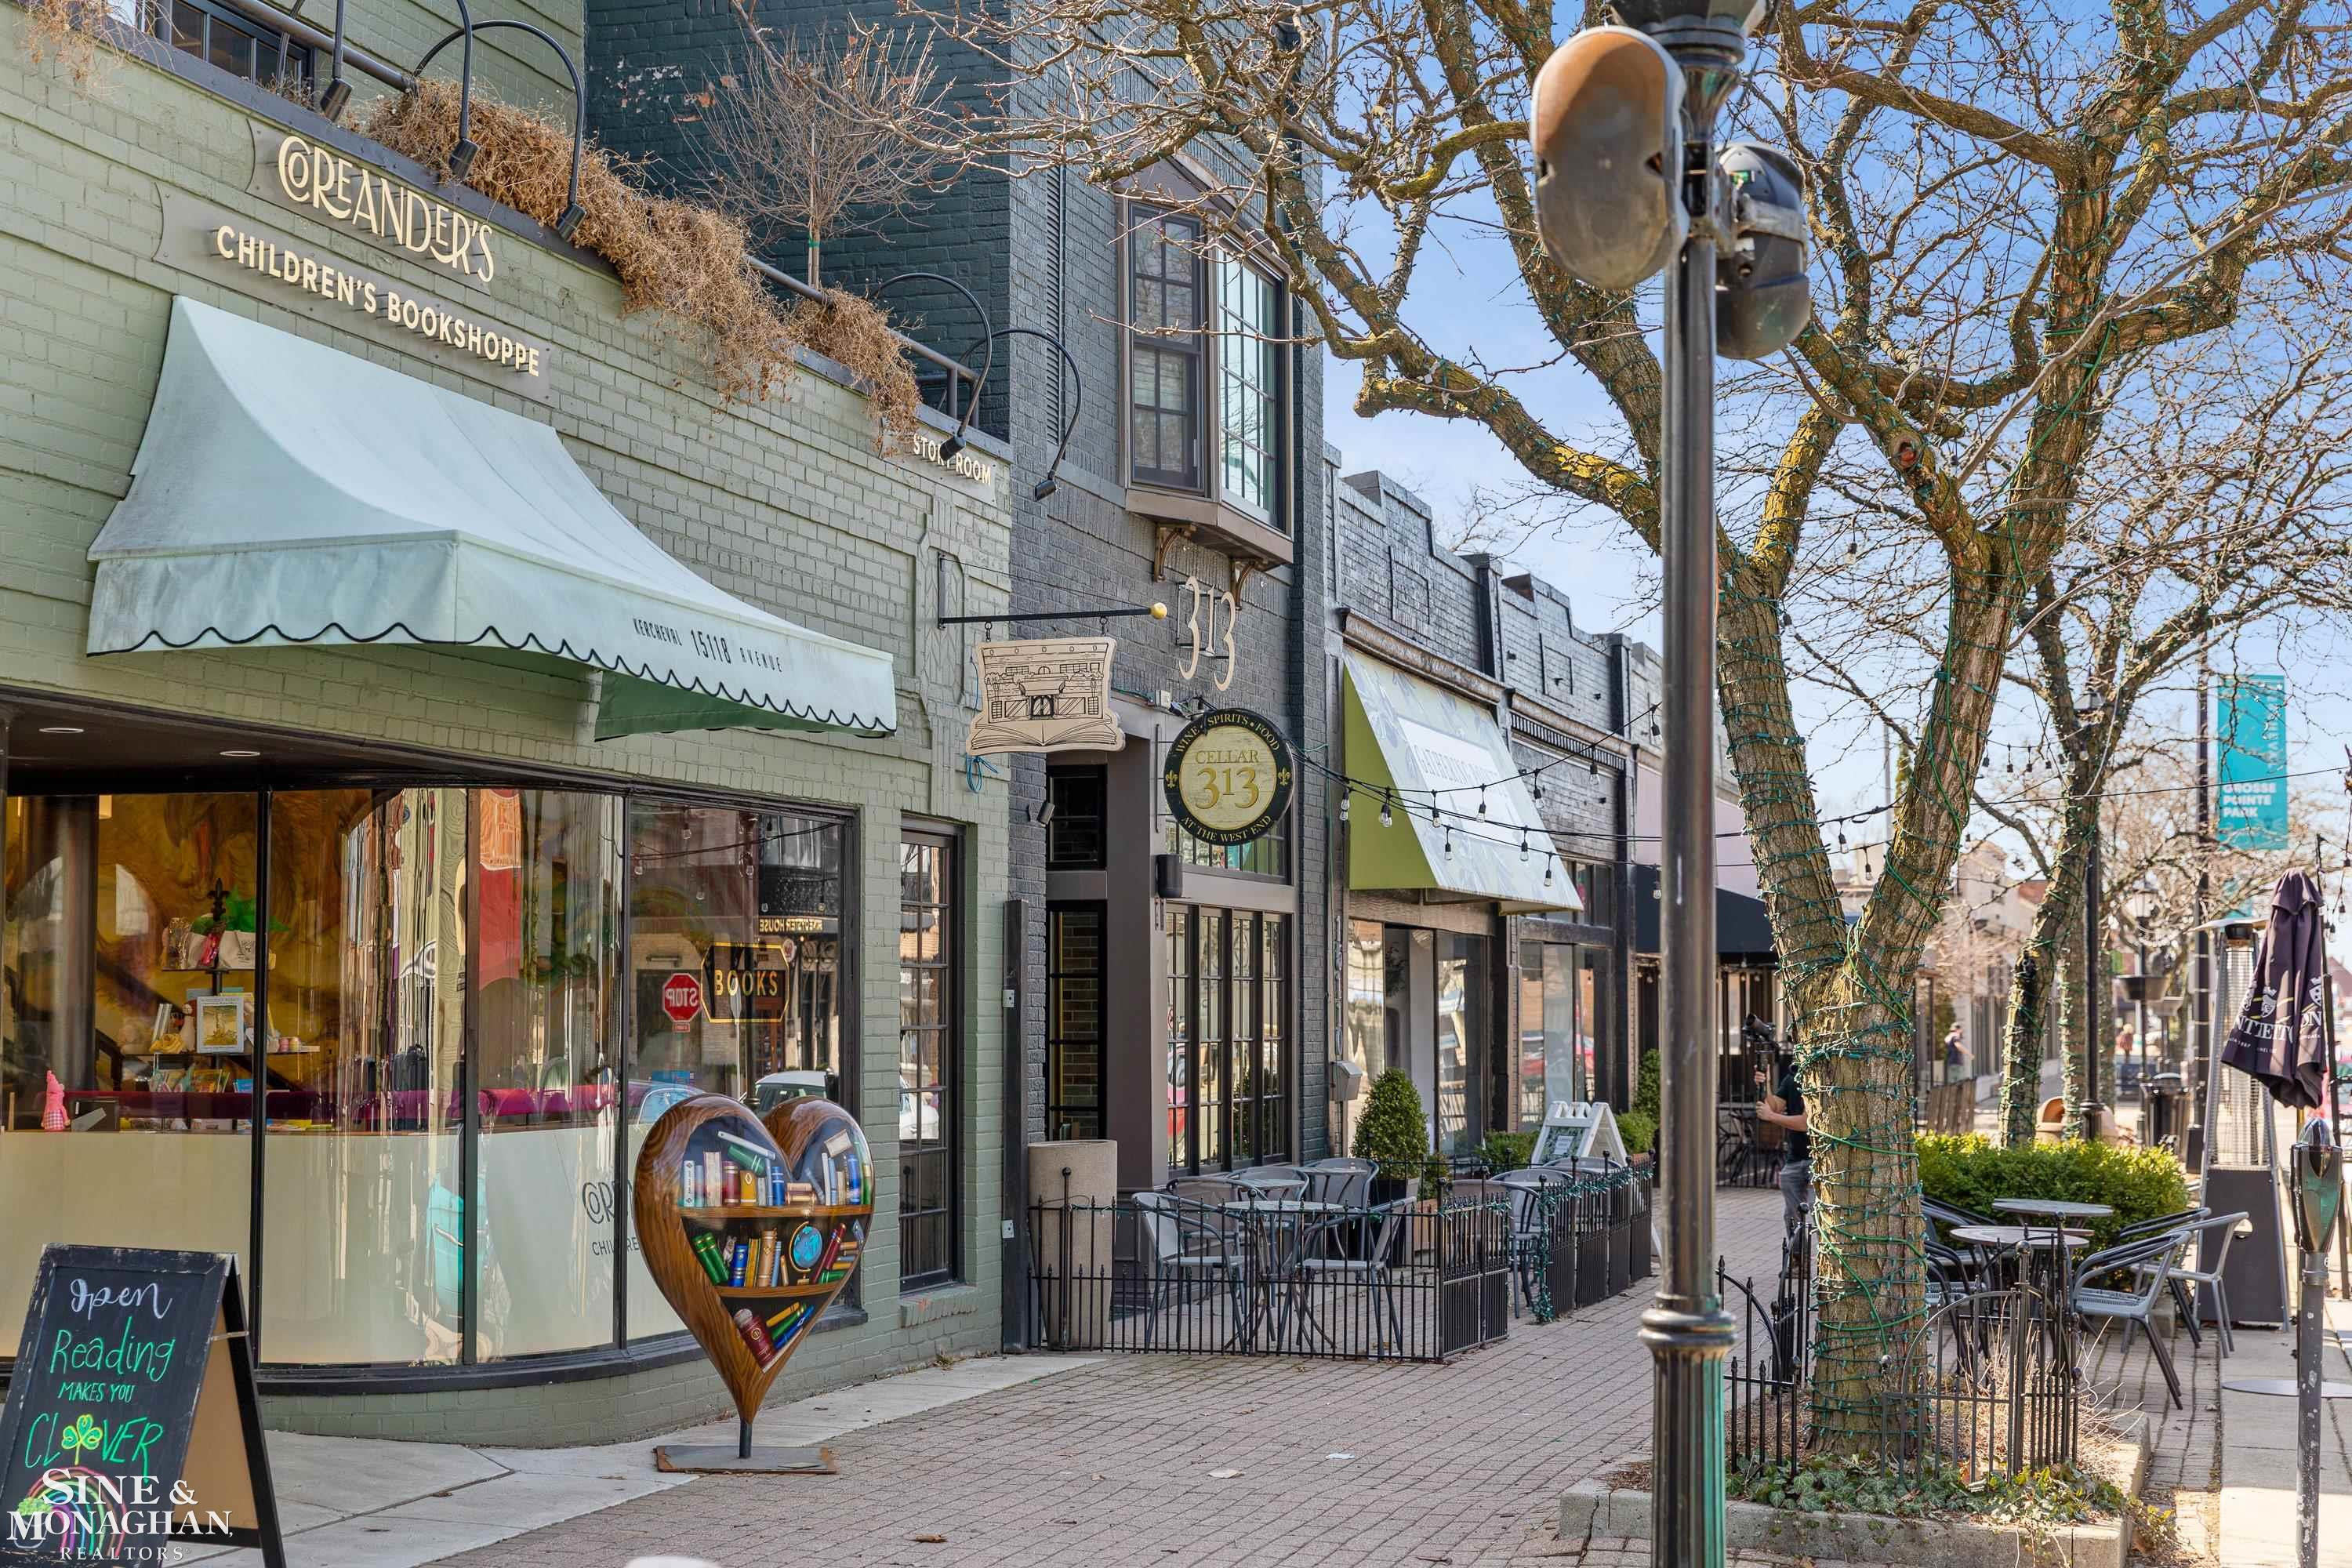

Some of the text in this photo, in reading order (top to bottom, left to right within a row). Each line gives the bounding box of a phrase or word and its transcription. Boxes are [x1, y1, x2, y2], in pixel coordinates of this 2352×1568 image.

[278, 136, 494, 283] COREANDER'S
[216, 224, 540, 377] CHILDREN'S BOOKSHOPPE
[956, 452, 991, 486] ROOM
[633, 618, 782, 673] KERCHEVAL 15118 AVENUE
[1178, 576, 1236, 691] 313
[1176, 713, 1279, 753] WINE SPIRITS FOOD
[1195, 750, 1260, 764] CELLAR
[1195, 767, 1260, 809] 313
[1181, 815, 1272, 842] AT THE WEST END
[2223, 807, 2258, 818] PARK
[714, 969, 778, 996] BOOKS
[49, 1316, 176, 1381] Reading
[58, 1381, 136, 1403] MAKES YOU
